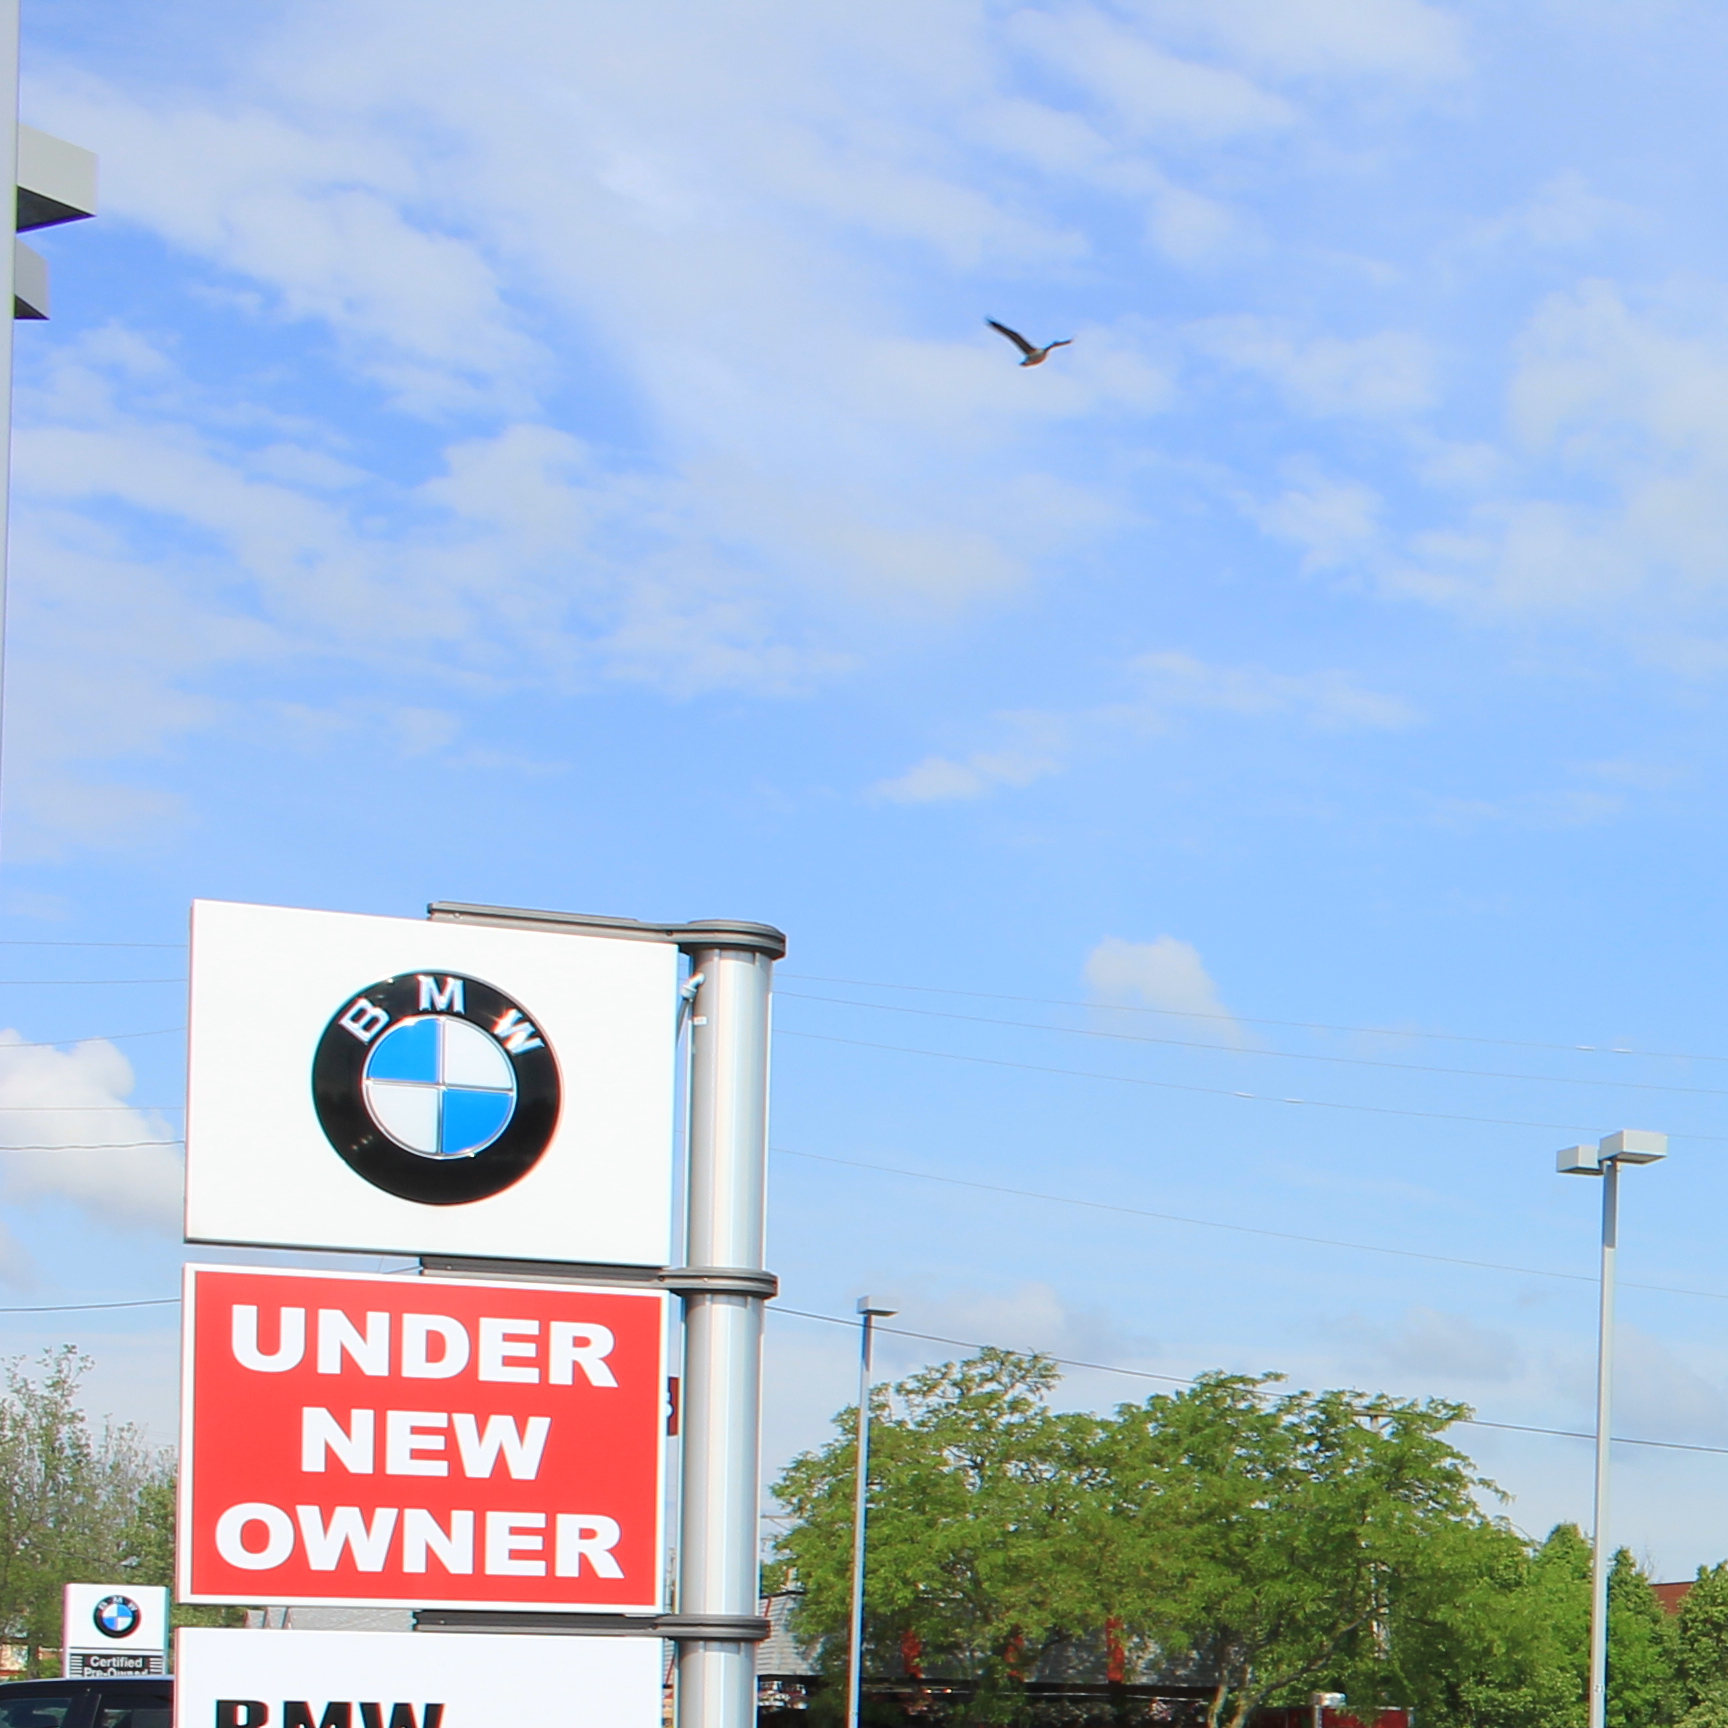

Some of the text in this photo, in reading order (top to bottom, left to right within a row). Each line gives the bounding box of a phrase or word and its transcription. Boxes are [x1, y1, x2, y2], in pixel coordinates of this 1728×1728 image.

[338, 973, 545, 1056] BMW
[231, 1304, 619, 1388] UNDER
[301, 1406, 552, 1481] NEW
[214, 1502, 626, 1579] OWNER
[90, 1656, 143, 1668] Certified
